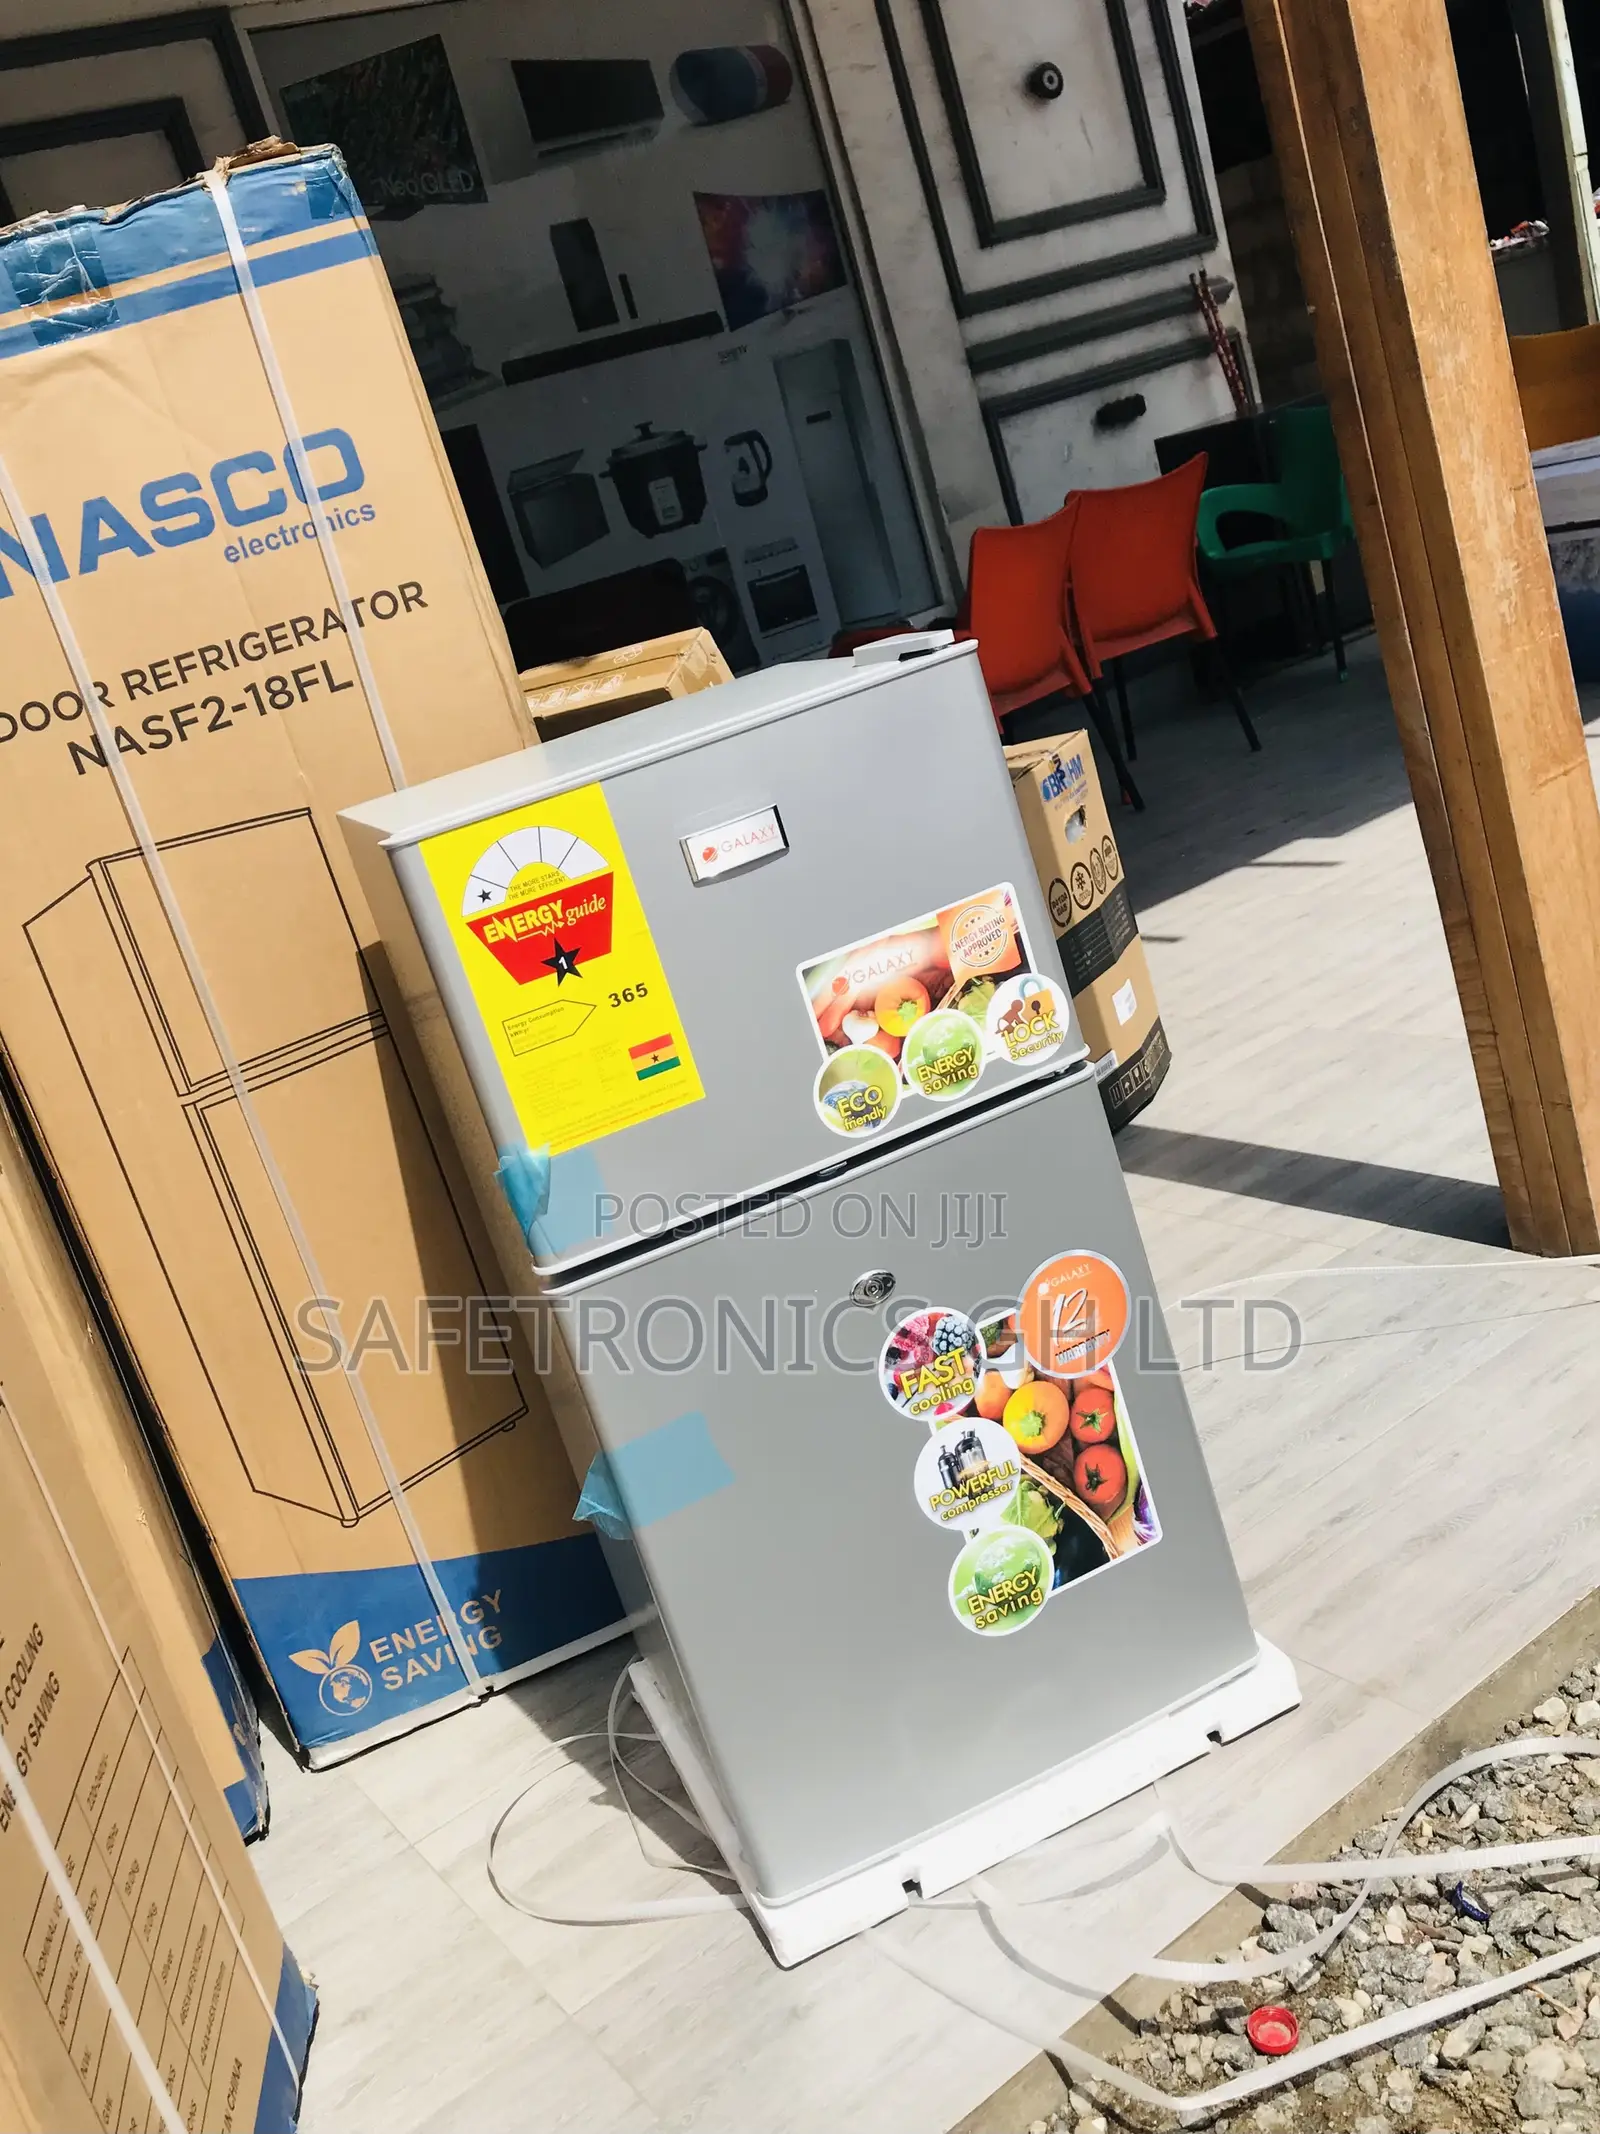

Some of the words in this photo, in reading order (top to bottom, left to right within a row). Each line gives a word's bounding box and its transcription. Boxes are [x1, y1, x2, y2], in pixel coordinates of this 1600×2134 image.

[0, 428, 365, 600] NASCO
[223, 503, 376, 563] electronics
[121, 581, 428, 701] REFRIGERATOR
[67, 660, 354, 776] NASF2-18FL
[721, 823, 776, 853] GALAXY
[509, 891, 519, 900] THE
[520, 885, 537, 897] MORE
[510, 884, 521, 893] THE
[523, 877, 540, 888] MORE
[541, 871, 560, 882] STARS
[482, 899, 563, 944] ENERGY
[566, 894, 607, 926] guide
[979, 914, 1005, 936] RATING
[558, 956, 568, 970] 1
[963, 928, 1002, 958] APPROVED
[852, 949, 915, 983] GALAXY
[608, 982, 649, 1009] 365
[1003, 1010, 1058, 1048] LOCK
[1010, 1029, 1065, 1061] Security
[917, 1044, 974, 1082] ENERGY
[924, 1062, 979, 1095] saving
[838, 1085, 885, 1118] ECO
[843, 1104, 888, 1132] friendly
[1050, 1263, 1090, 1287] GALAXY
[1052, 1288, 1089, 1348] 12
[900, 1346, 967, 1400] FAST
[909, 1377, 976, 1416] cooling
[929, 1460, 1019, 1511] POWERFUL
[940, 1480, 1014, 1521] compressor
[967, 1566, 1040, 1615] ENERGY
[974, 1586, 1044, 1630] saving
[5, 1622, 43, 1710] COOLING
[381, 1626, 502, 1691] SAVING
[0, 1737, 32, 1833] ENEGY
[28, 1671, 60, 1746] SAVING
[53, 1854, 76, 1920] VOGE
[73, 1886, 100, 1970] FRENCY
[226, 2057, 243, 2111] CHINA
